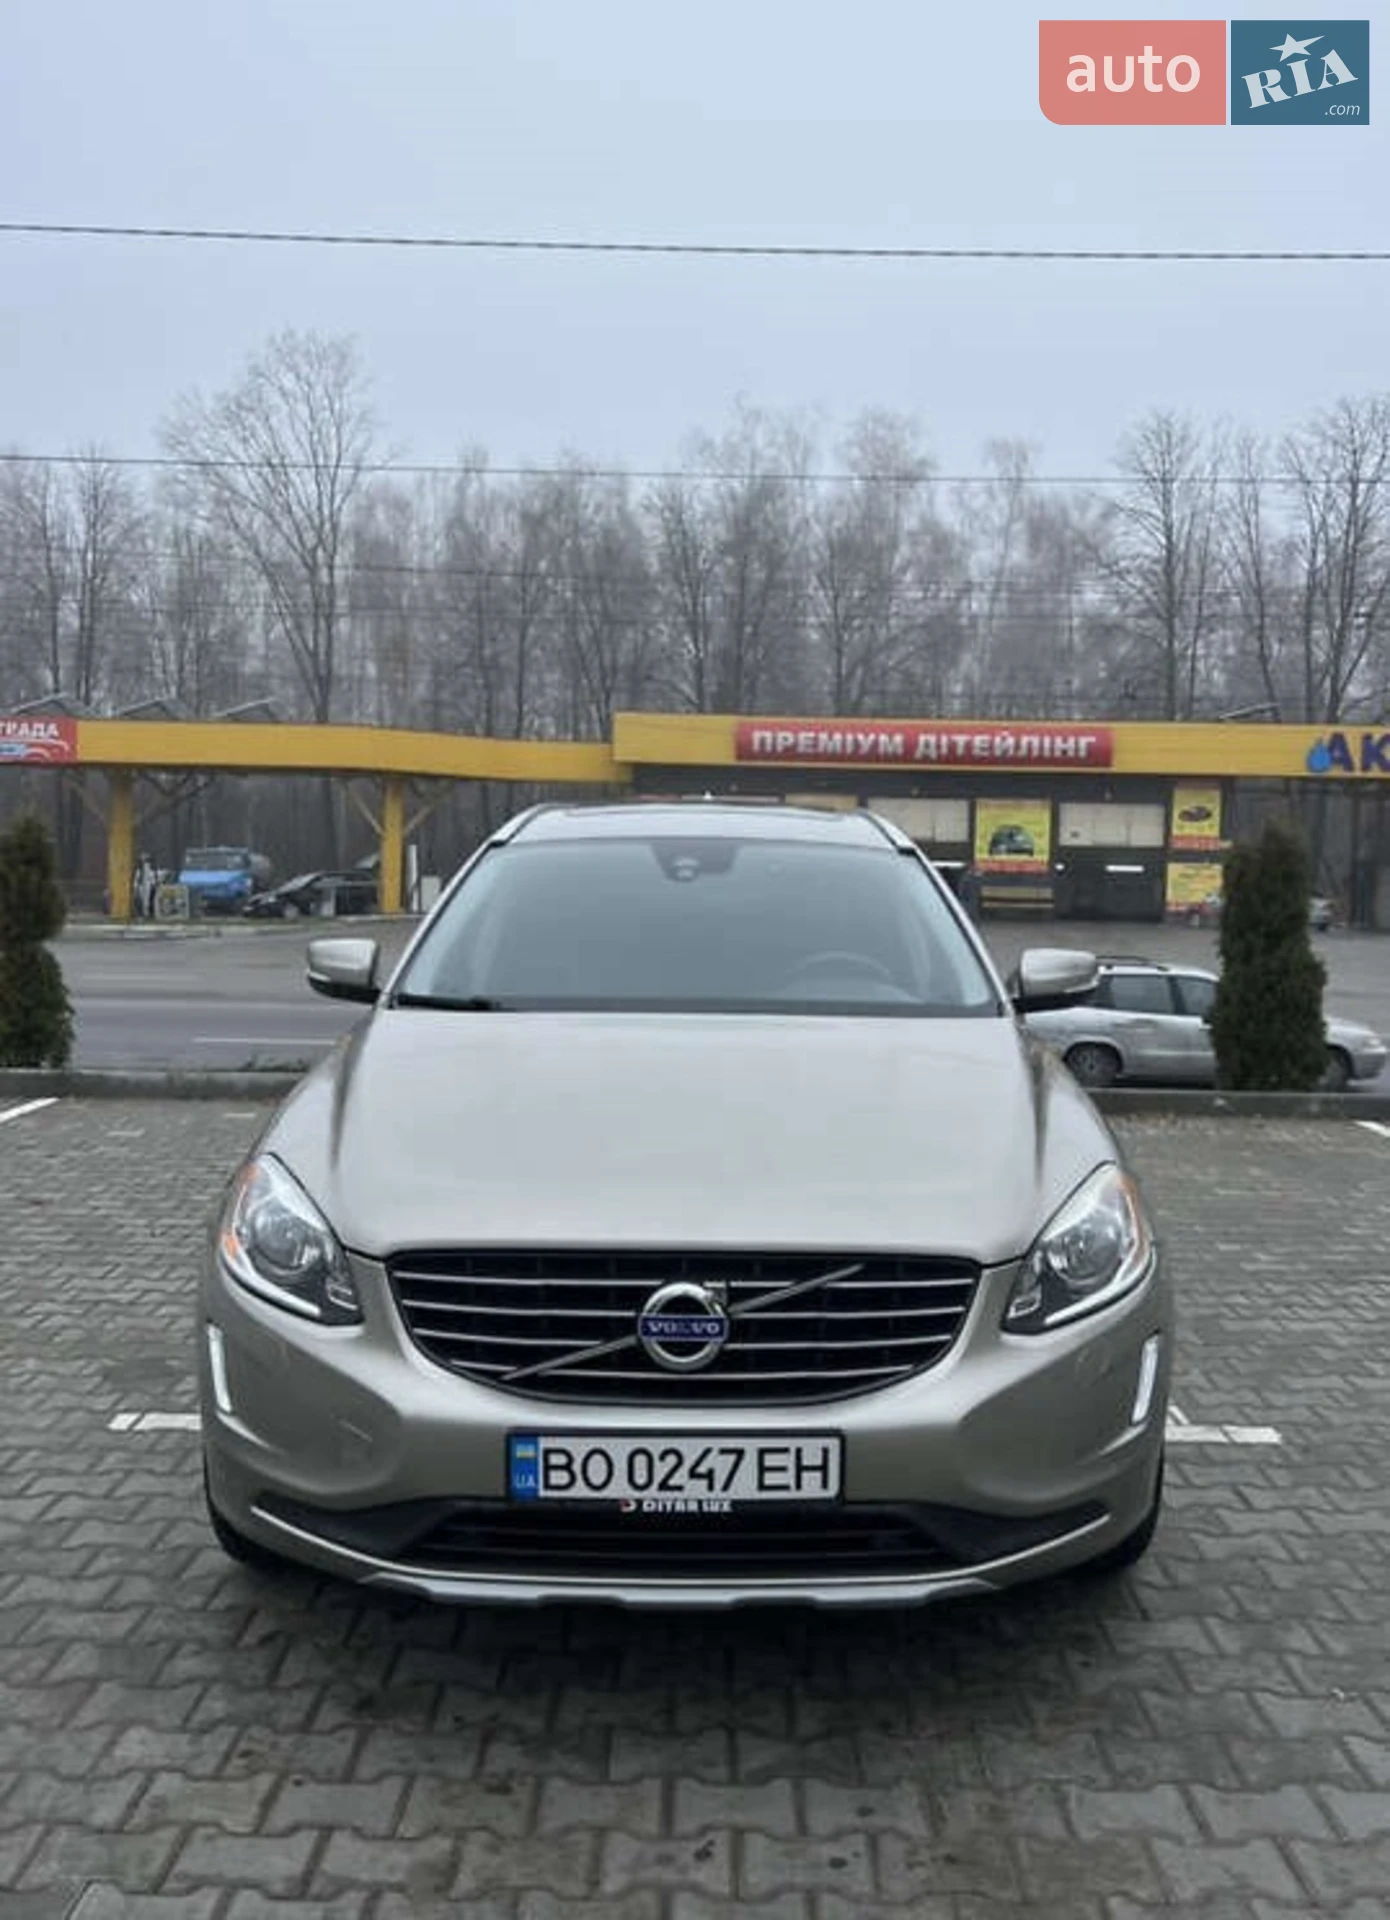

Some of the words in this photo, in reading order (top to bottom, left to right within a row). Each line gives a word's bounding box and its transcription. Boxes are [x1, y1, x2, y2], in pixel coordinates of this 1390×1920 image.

[752, 730, 904, 756] ПРЕМІУМ
[914, 730, 1097, 760] ДІТЕЙЛІНГ
[647, 1321, 720, 1334] VOLVO
[542, 1447, 614, 1492] BO
[627, 1447, 746, 1492] 0247
[757, 1447, 830, 1491] EH
[515, 1474, 536, 1488] UA
